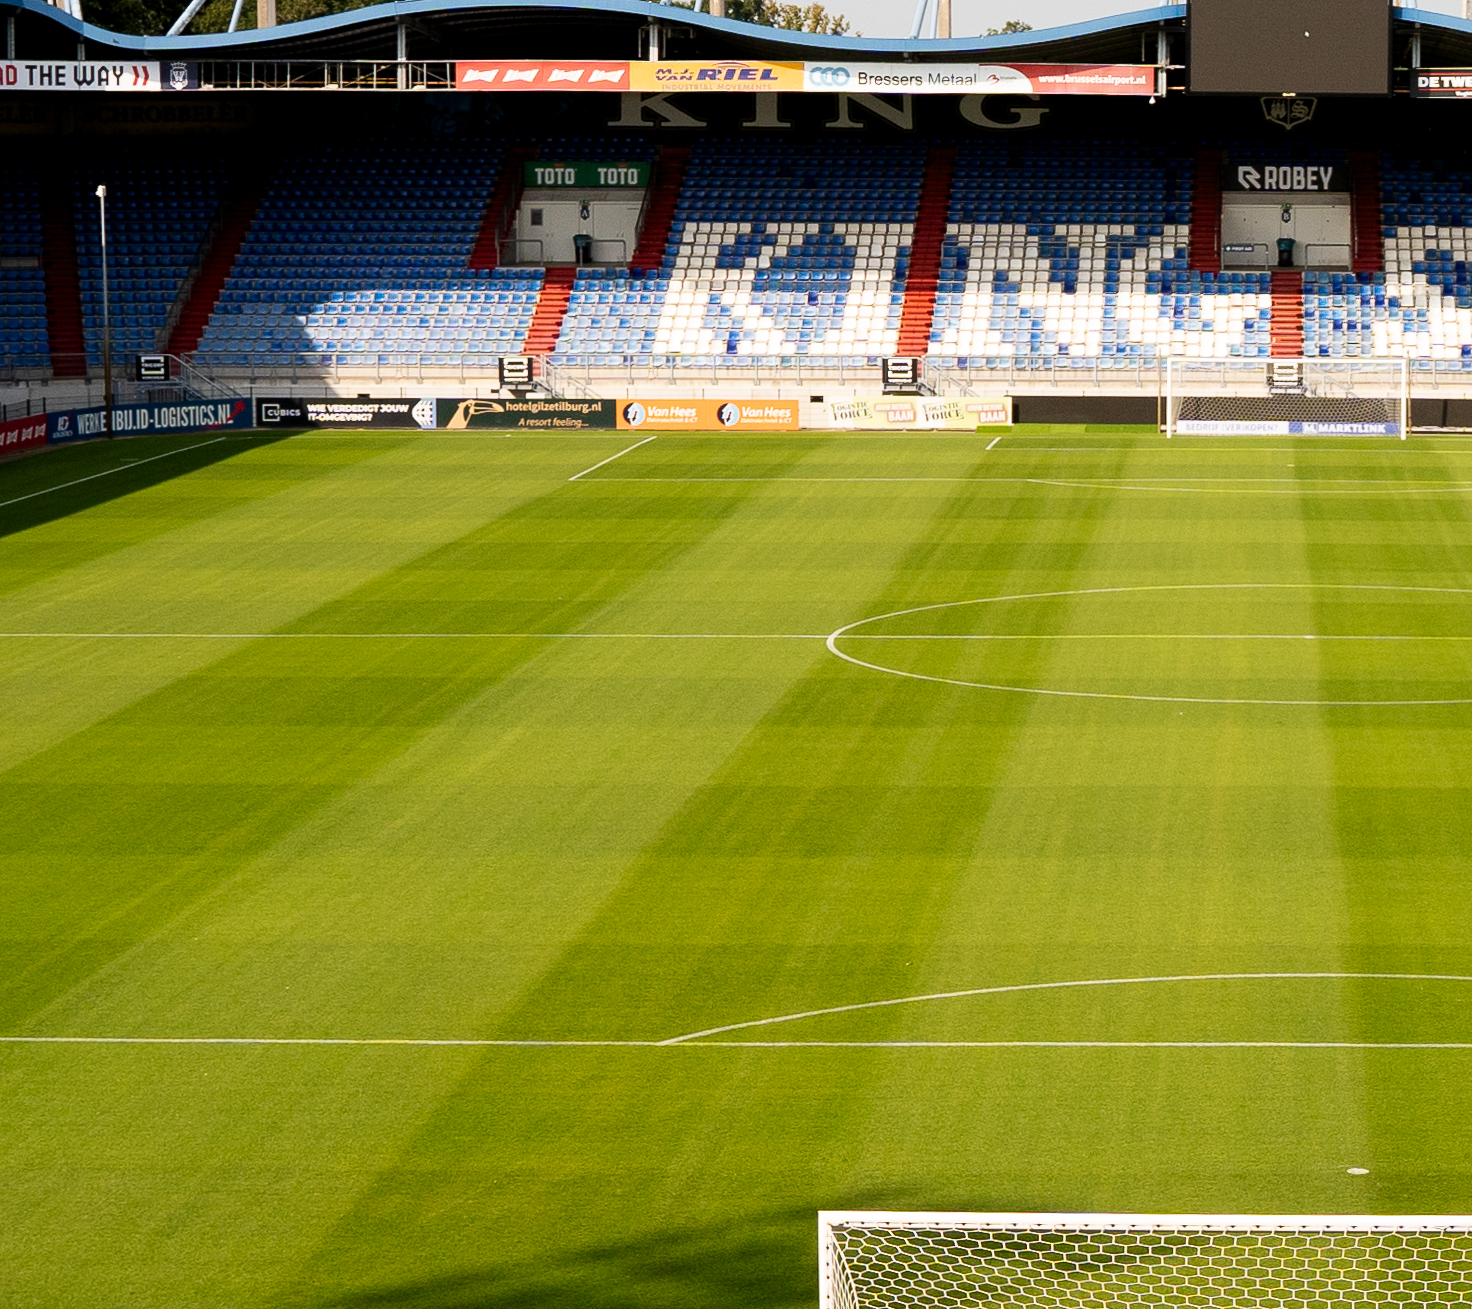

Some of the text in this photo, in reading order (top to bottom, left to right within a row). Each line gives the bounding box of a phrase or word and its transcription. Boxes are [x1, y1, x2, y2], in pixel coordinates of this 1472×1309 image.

[25, 65, 66, 87] THE
[73, 65, 124, 87] WAY
[696, 68, 779, 81] RIEL
[857, 72, 977, 87] Bressers Metaal
[1039, 74, 1146, 86] www.brusselsairport.nl
[1418, 76, 1439, 88] DE
[535, 167, 638, 185] TOTO TOTO
[1264, 165, 1333, 190] ROBEY
[267, 409, 301, 417] CUBICS
[307, 404, 410, 413] WIE VERDEDIGT JOUW
[506, 401, 602, 414] hotelgilzetilburg.nl
[647, 406, 697, 417] Van Hees
[741, 406, 791, 417] Van Hees
[78, 404, 234, 435] WERKEBIJ.ID-LOGISTICS.NL
[833, 409, 871, 422] FORCE
[888, 411, 915, 422] BAAN
[925, 409, 963, 422] FORCE
[980, 411, 1007, 423] BAAN
[526, 418, 551, 427] resort
[1186, 423, 1219, 431] BEDRIJF
[1319, 423, 1387, 433] MARKTLINK
